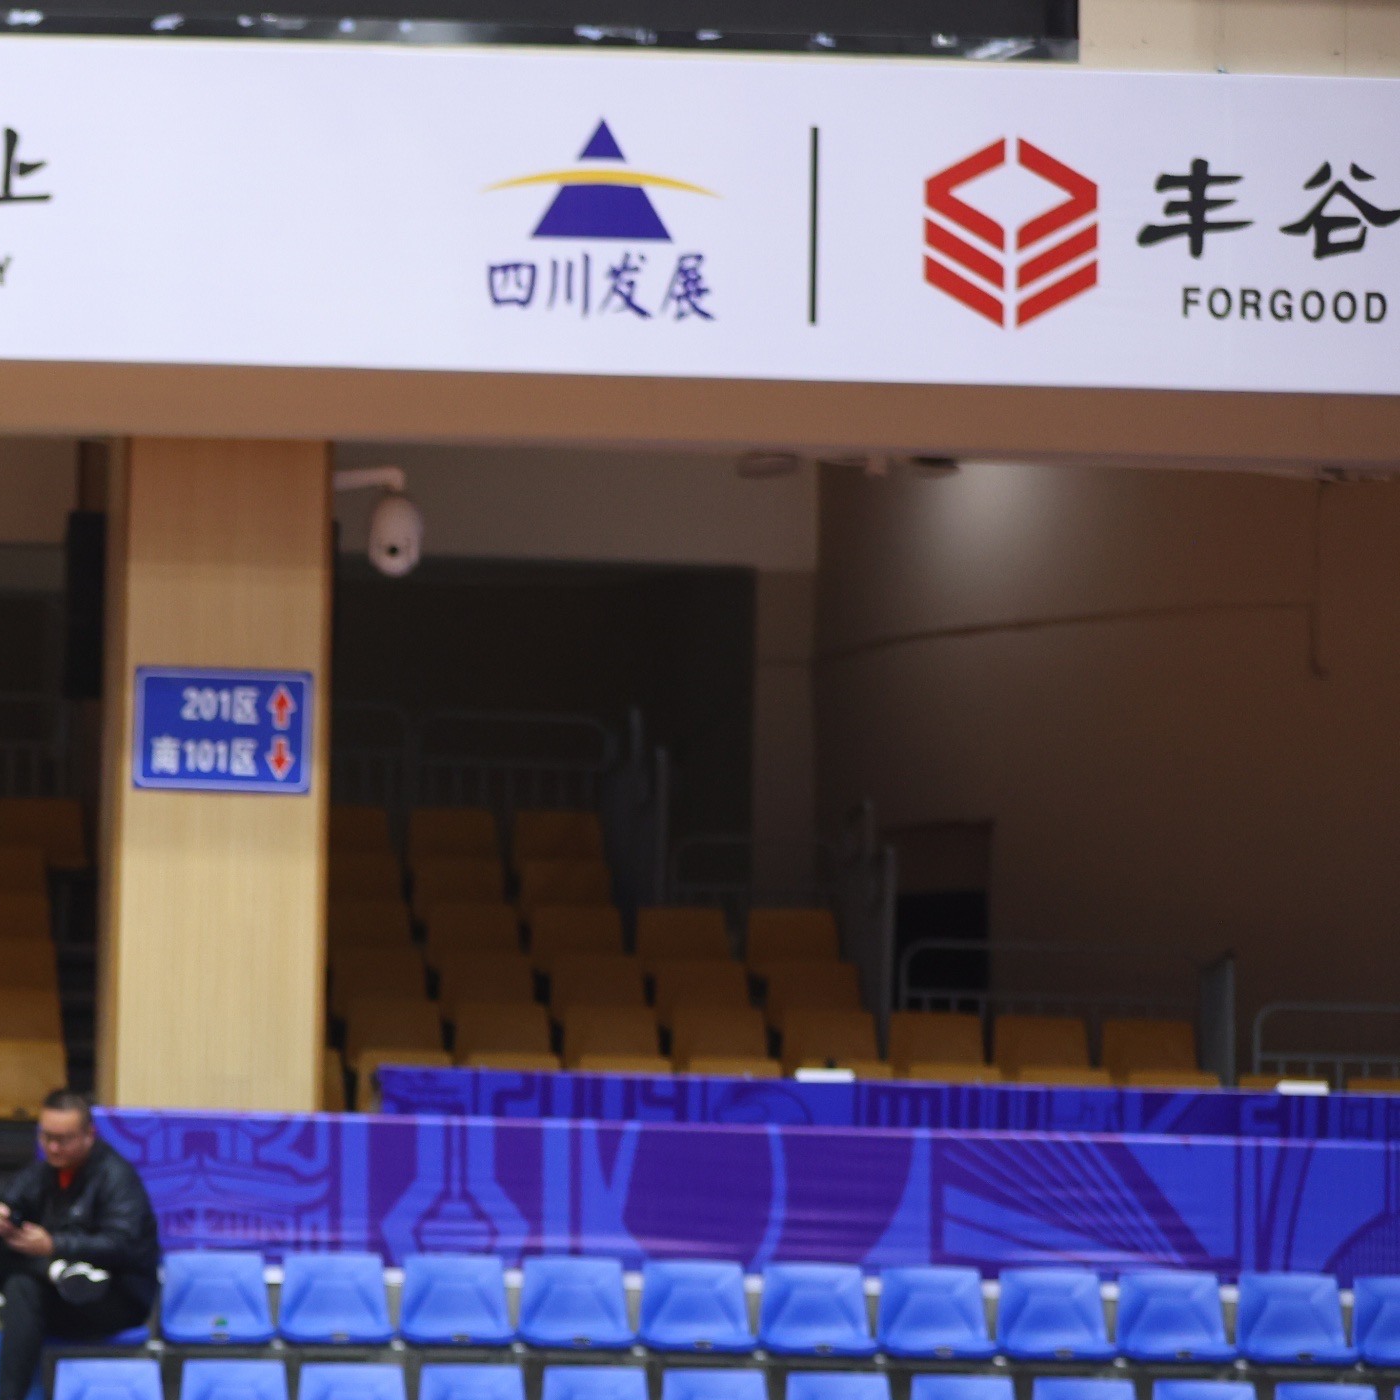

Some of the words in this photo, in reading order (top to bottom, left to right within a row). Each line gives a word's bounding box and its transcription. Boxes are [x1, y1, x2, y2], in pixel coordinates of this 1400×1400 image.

[1136, 157, 1400, 261] 丰谷
[485, 251, 717, 322] 四川发展
[1181, 286, 1389, 324] FORGOOD
[180, 685, 260, 725] 201区
